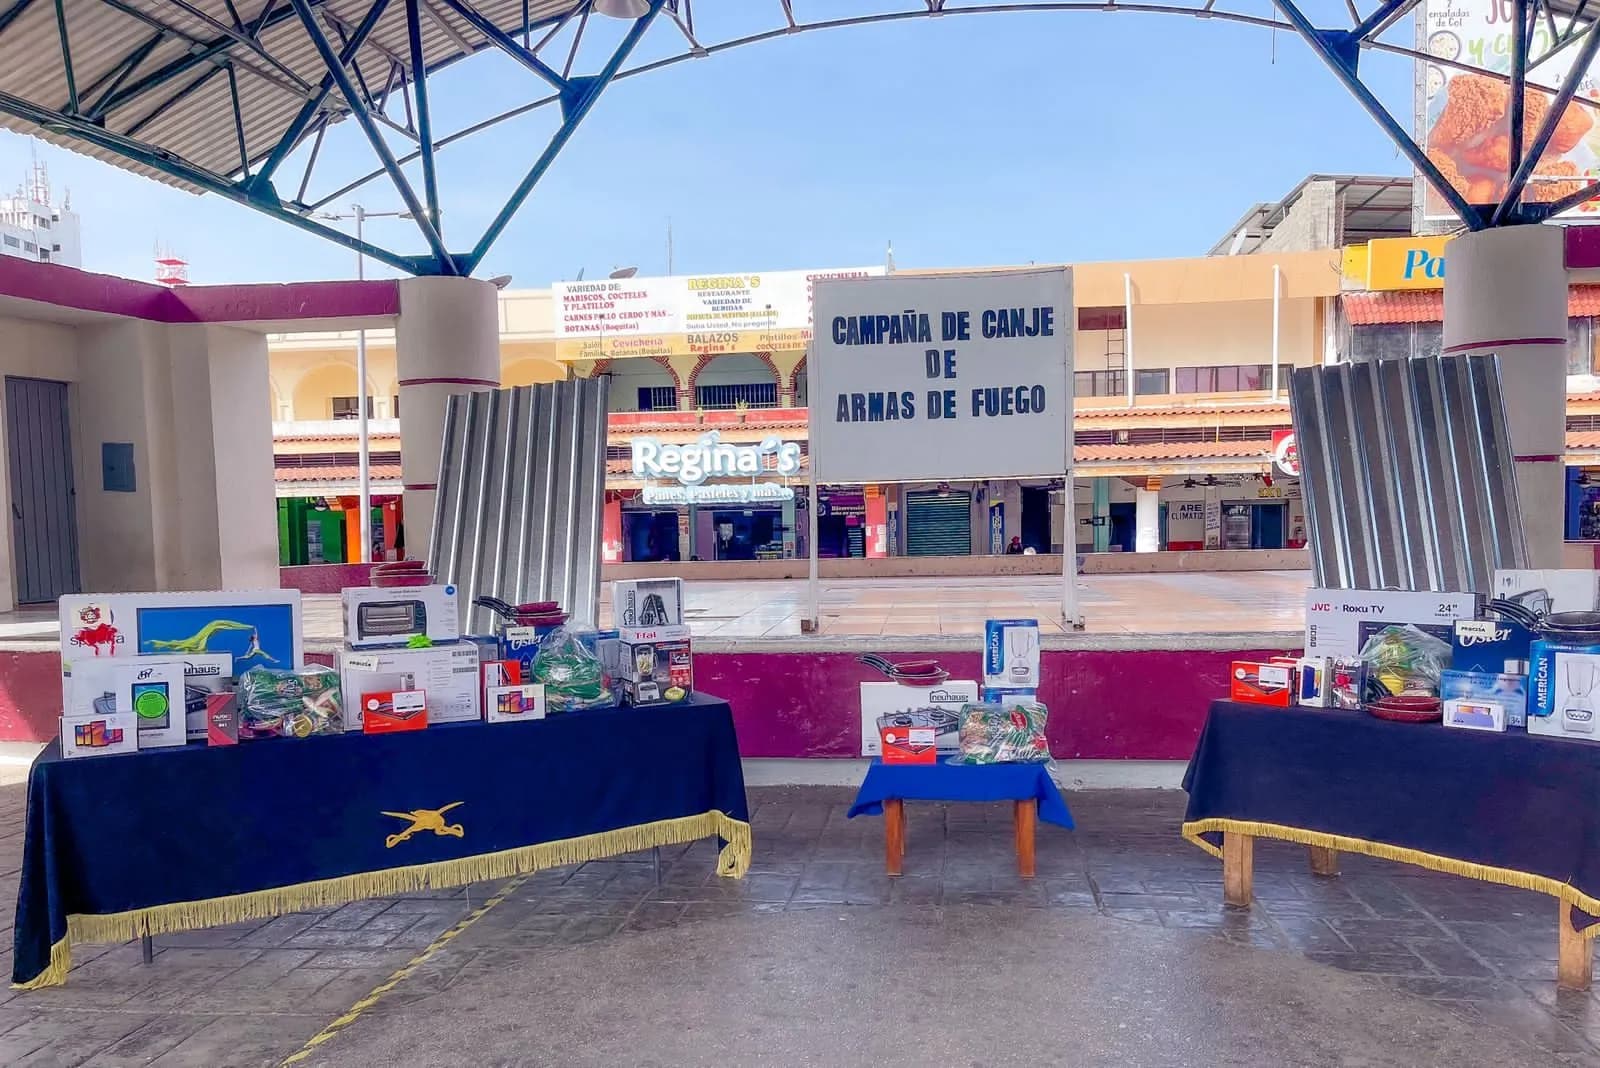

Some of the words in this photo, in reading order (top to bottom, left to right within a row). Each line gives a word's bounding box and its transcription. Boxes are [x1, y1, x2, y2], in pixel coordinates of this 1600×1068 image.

[1428, 9, 1470, 19] ensaladas
[1435, 17, 1446, 27] de
[567, 284, 606, 293] VARIEDAD
[607, 291, 648, 300] COCTELES
[571, 302, 615, 311] PLATILLOS
[619, 311, 643, 319] CERDO
[565, 324, 600, 332] BOTANAS
[832, 309, 932, 345] CAMPAÑA
[942, 311, 970, 341] DE
[981, 306, 1054, 338] CANJE
[925, 349, 957, 379] DE
[836, 391, 915, 422] ARMAS
[927, 390, 957, 420] DE
[971, 384, 1045, 417] FUEGO
[689, 487, 738, 499] Pasteles
[1311, 603, 1330, 612] JVC
[1342, 604, 1368, 613] Roku
[1371, 605, 1385, 614] TV
[184, 664, 219, 674] uhaus
